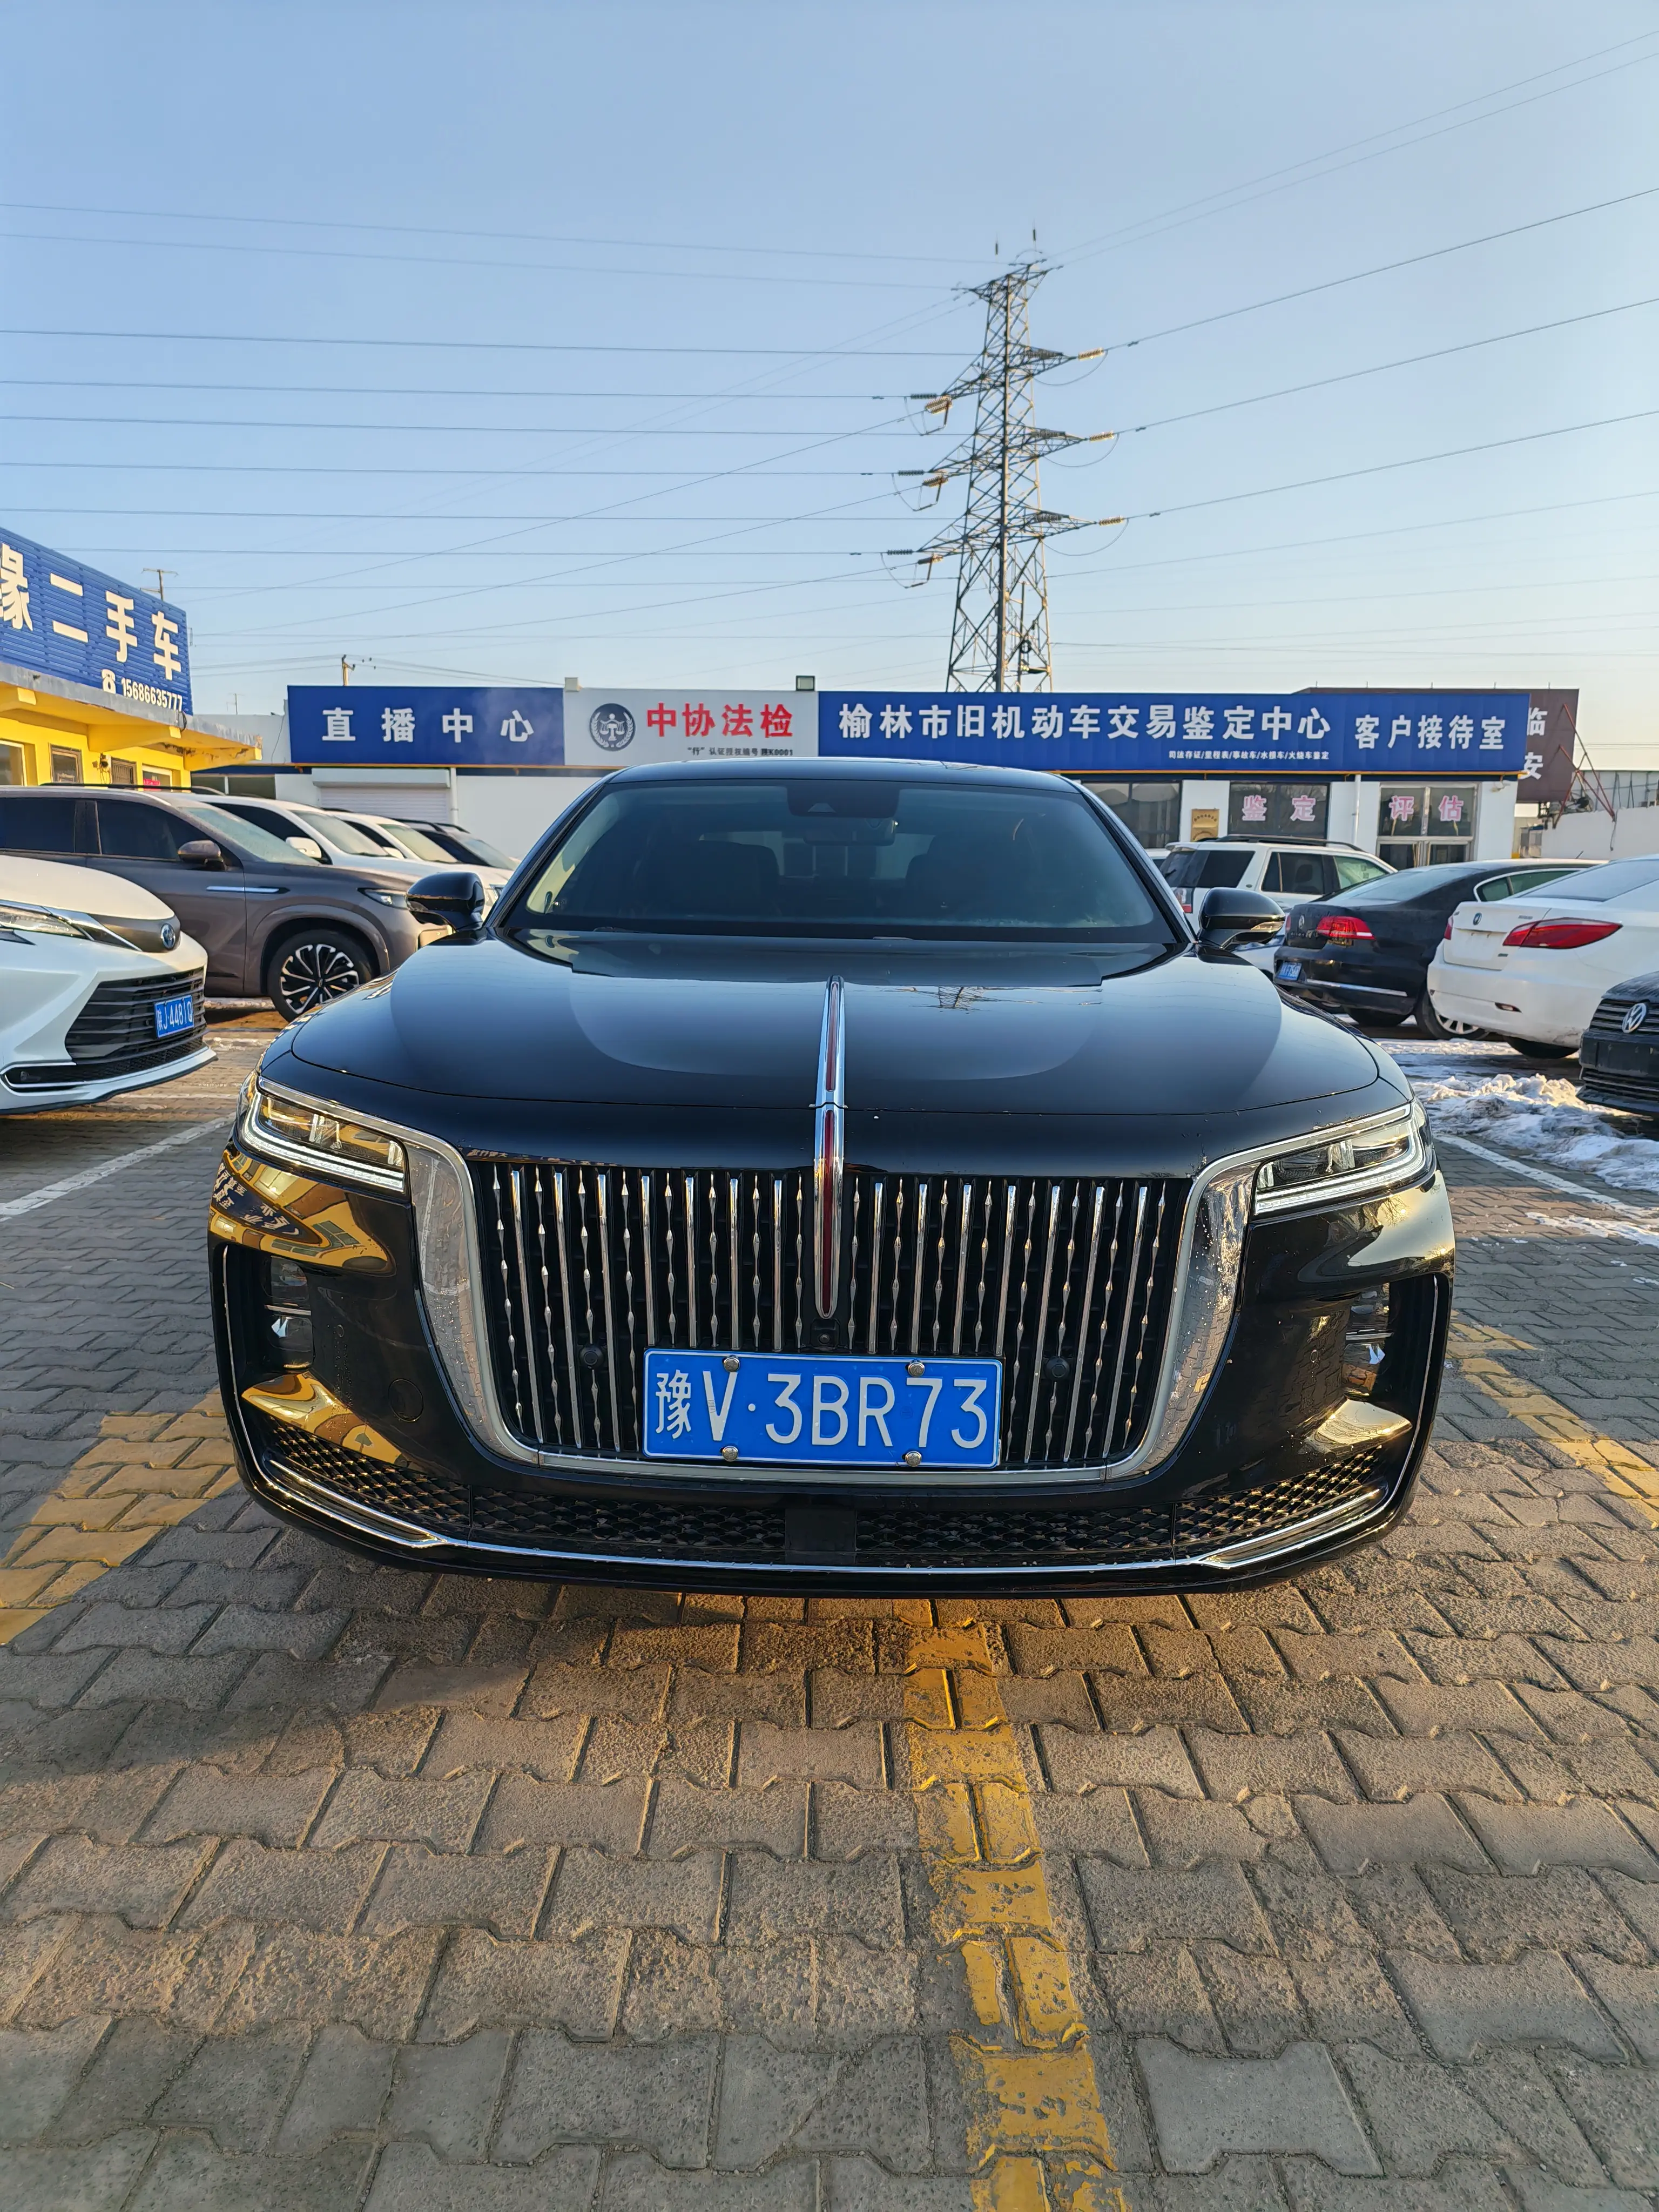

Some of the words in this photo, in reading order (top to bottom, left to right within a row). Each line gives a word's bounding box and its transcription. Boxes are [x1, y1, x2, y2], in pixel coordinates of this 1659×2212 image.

[121, 677, 183, 712] 15686635777
[322, 707, 534, 743] 直播中心
[647, 702, 793, 738] 中协法检
[839, 703, 1331, 740] 榆林市旧机动车交易鉴定中心
[1355, 713, 1506, 750] 客户接待室
[1242, 794, 1316, 821] 鉴定
[1389, 795, 1464, 822] 评估
